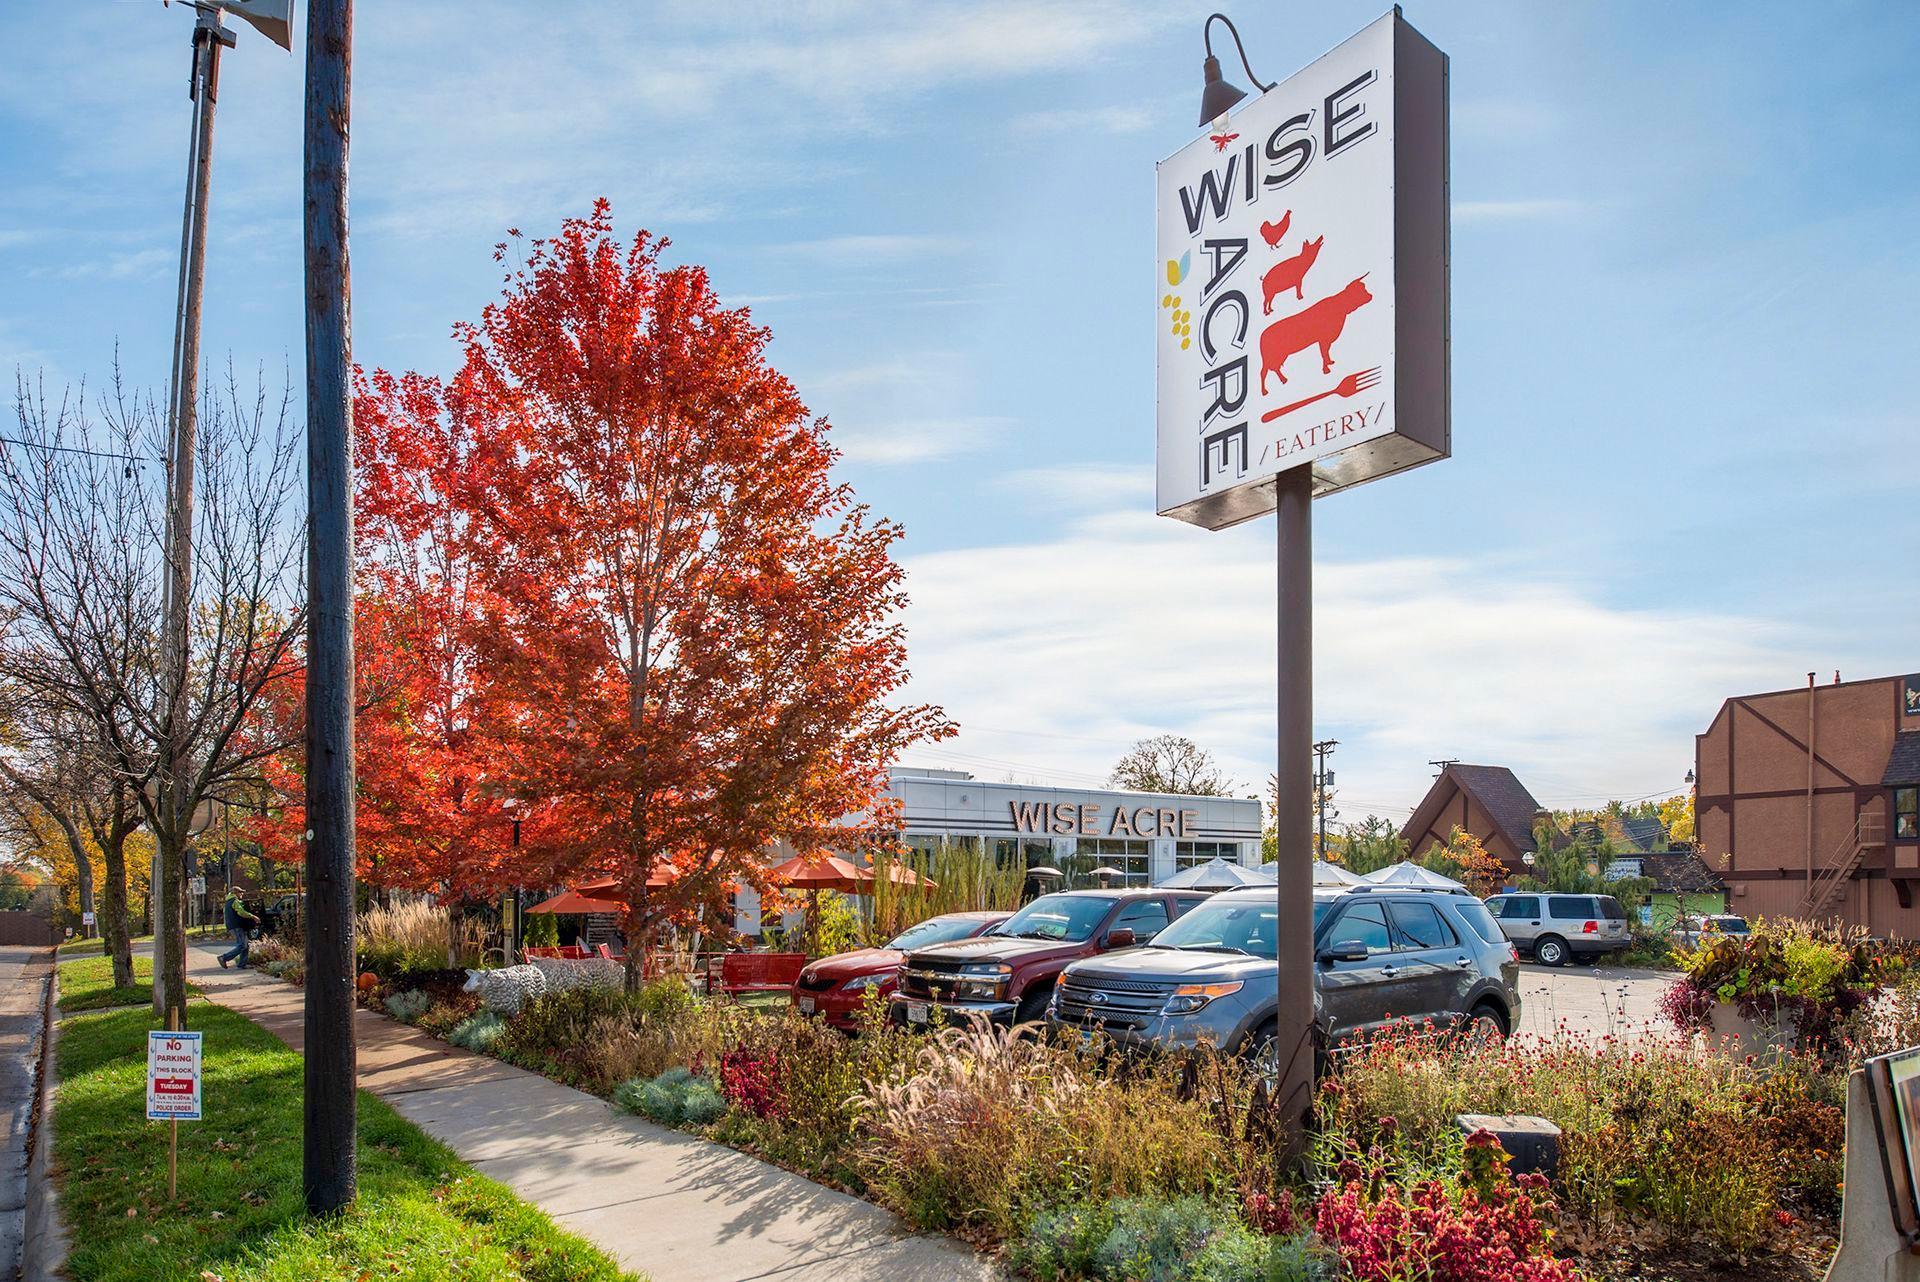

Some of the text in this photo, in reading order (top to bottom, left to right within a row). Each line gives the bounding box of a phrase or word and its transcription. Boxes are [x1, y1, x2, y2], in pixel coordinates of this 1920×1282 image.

[1179, 69, 1379, 238] WISE
[1199, 238, 1249, 492] ACRE
[1009, 800, 1201, 838] WISE ACRE
[156, 1054, 192, 1062] PARKING
[166, 1041, 182, 1051] NO
